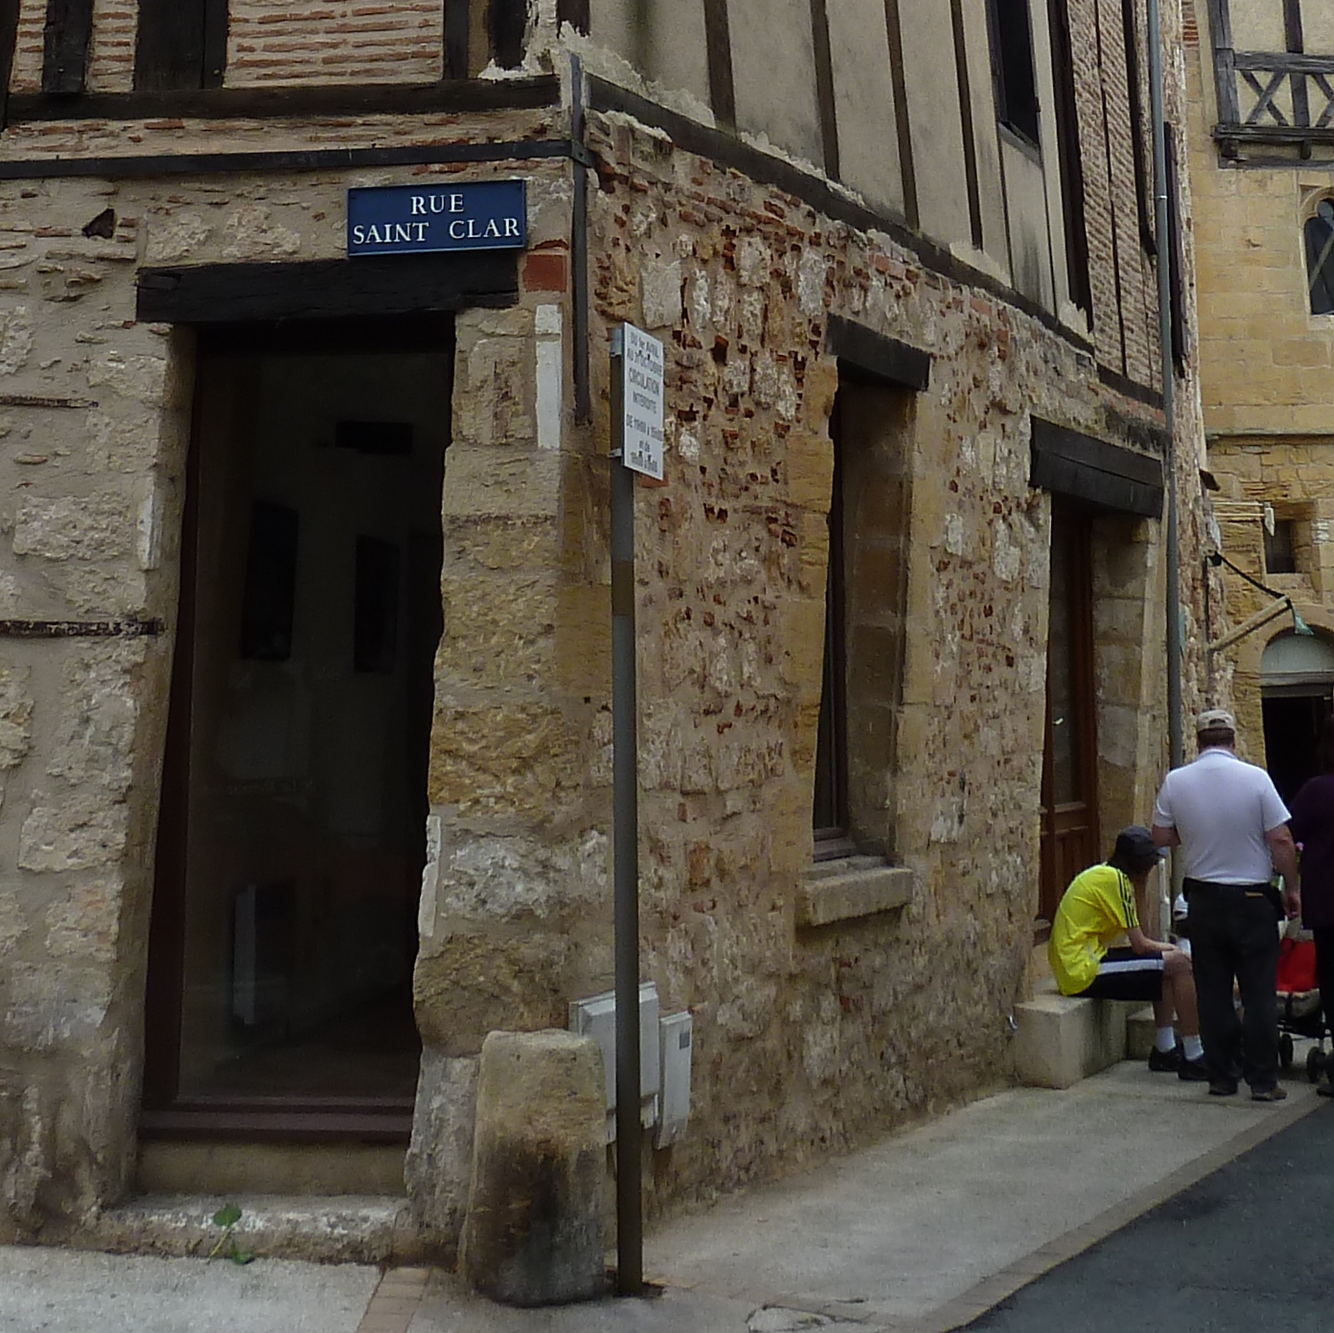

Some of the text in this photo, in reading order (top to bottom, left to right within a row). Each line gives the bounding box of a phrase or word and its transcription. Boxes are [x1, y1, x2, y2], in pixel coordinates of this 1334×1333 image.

[410, 193, 465, 215] RUE
[353, 217, 520, 245] SAINT CLAR
[629, 367, 660, 396] CIRCULATION
[633, 391, 657, 414] INTERDITE
